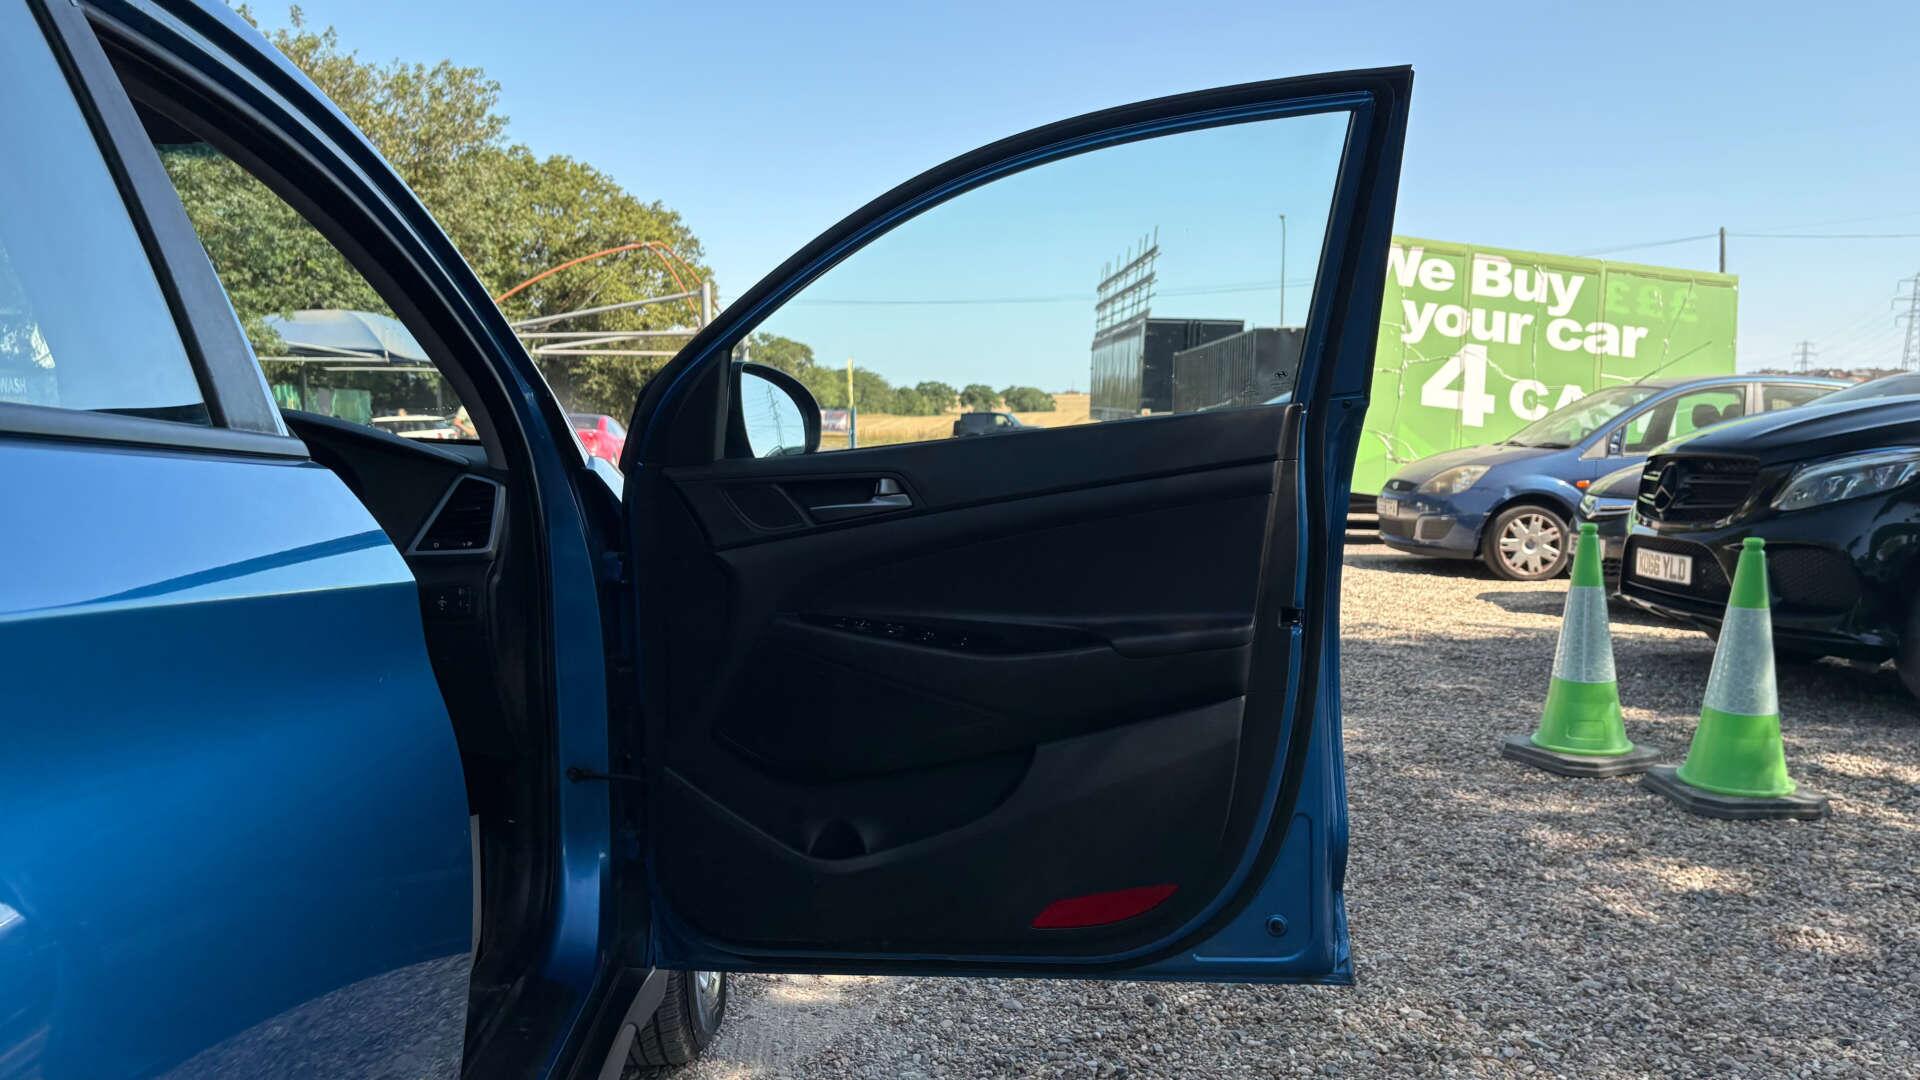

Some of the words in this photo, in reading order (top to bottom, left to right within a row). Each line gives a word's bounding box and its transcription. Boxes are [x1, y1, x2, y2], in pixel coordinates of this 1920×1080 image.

[1471, 253, 1585, 316] Buy
[1400, 299, 1534, 345] your
[1546, 317, 1649, 359] car
[1420, 343, 1496, 428] 4
[1662, 556, 1687, 581] YLD
